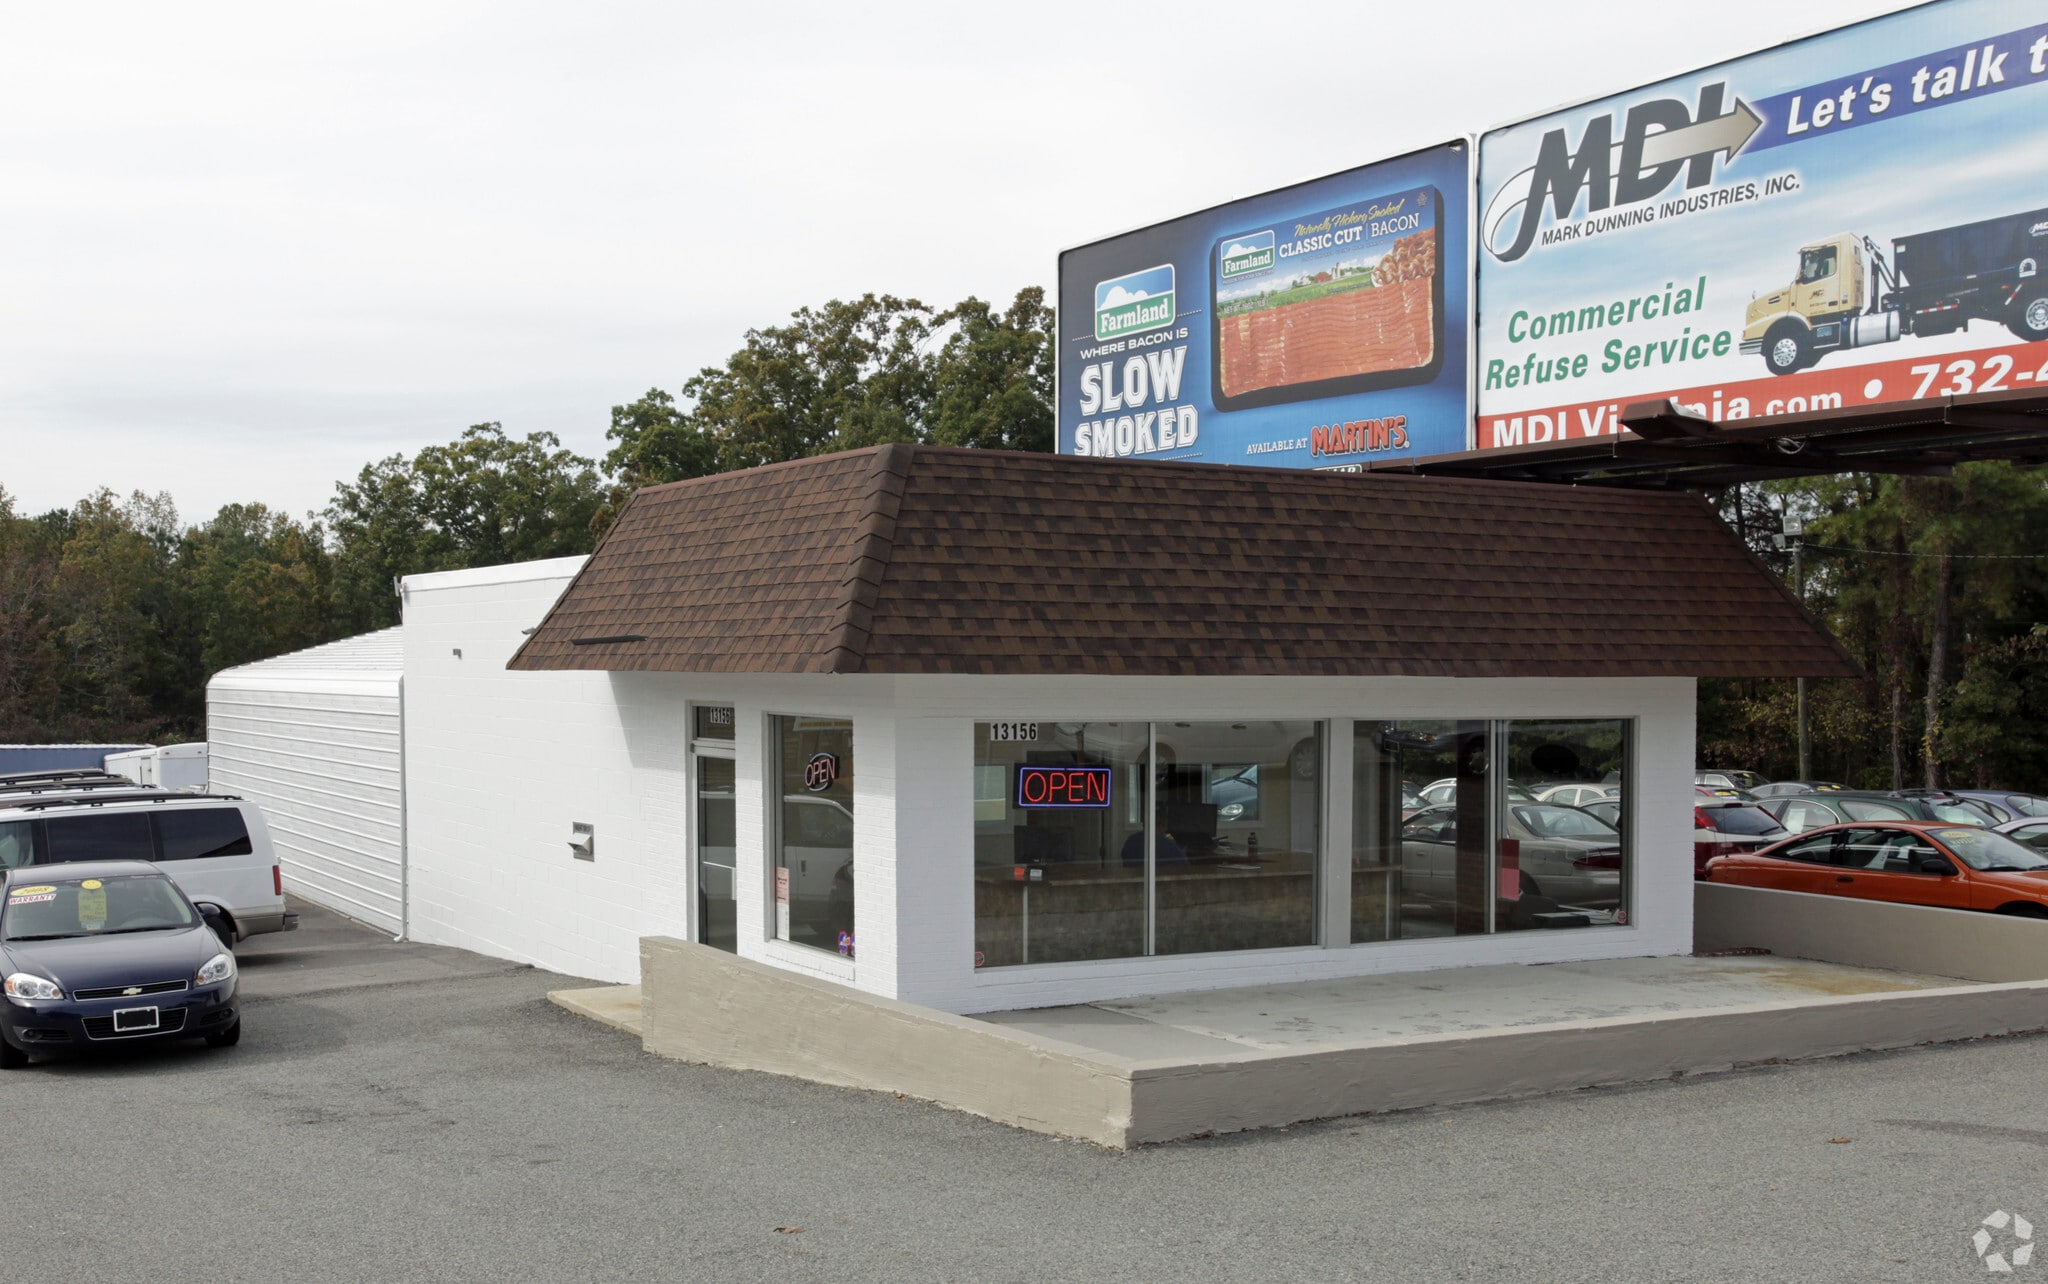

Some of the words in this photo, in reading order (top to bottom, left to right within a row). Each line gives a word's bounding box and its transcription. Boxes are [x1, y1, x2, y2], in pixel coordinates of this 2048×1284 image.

[1787, 76, 1892, 135] Let's
[1911, 44, 2009, 103] talk
[1489, 81, 1726, 260] MDI
[1294, 217, 1332, 238] Naturally
[1331, 210, 1368, 227] Hickory
[1368, 198, 1405, 221] Smoked
[1541, 223, 1581, 246] MARK
[1585, 206, 1655, 236] DUNNING
[1659, 183, 1759, 219] INDUSTRIES,
[1765, 174, 1800, 196] INC.
[1279, 233, 1332, 258] CLASSIC
[1334, 226, 1363, 245] CUT
[1371, 213, 1420, 237] BACON
[1224, 250, 1271, 274] Farmland
[1100, 298, 1169, 333] Farmland
[1508, 275, 1706, 344] Commercial
[1080, 342, 1125, 359] WHERE
[1128, 331, 1173, 349] BACON
[1176, 327, 1188, 339] IS
[1485, 353, 1588, 391] Refuse
[1601, 327, 1731, 374] Service
[1080, 345, 1187, 416] SLOW
[1074, 404, 1198, 459] SMOKED
[1246, 439, 1294, 455] AVAILABLE
[1295, 438, 1308, 449] AT
[1311, 415, 1408, 457] MARTIN'S
[1493, 411, 1567, 448] MDI
[992, 722, 1037, 740] 13156
[805, 757, 836, 786] OPEN
[1024, 772, 1106, 802] OPEN
[10, 894, 54, 904] WARRANTY
